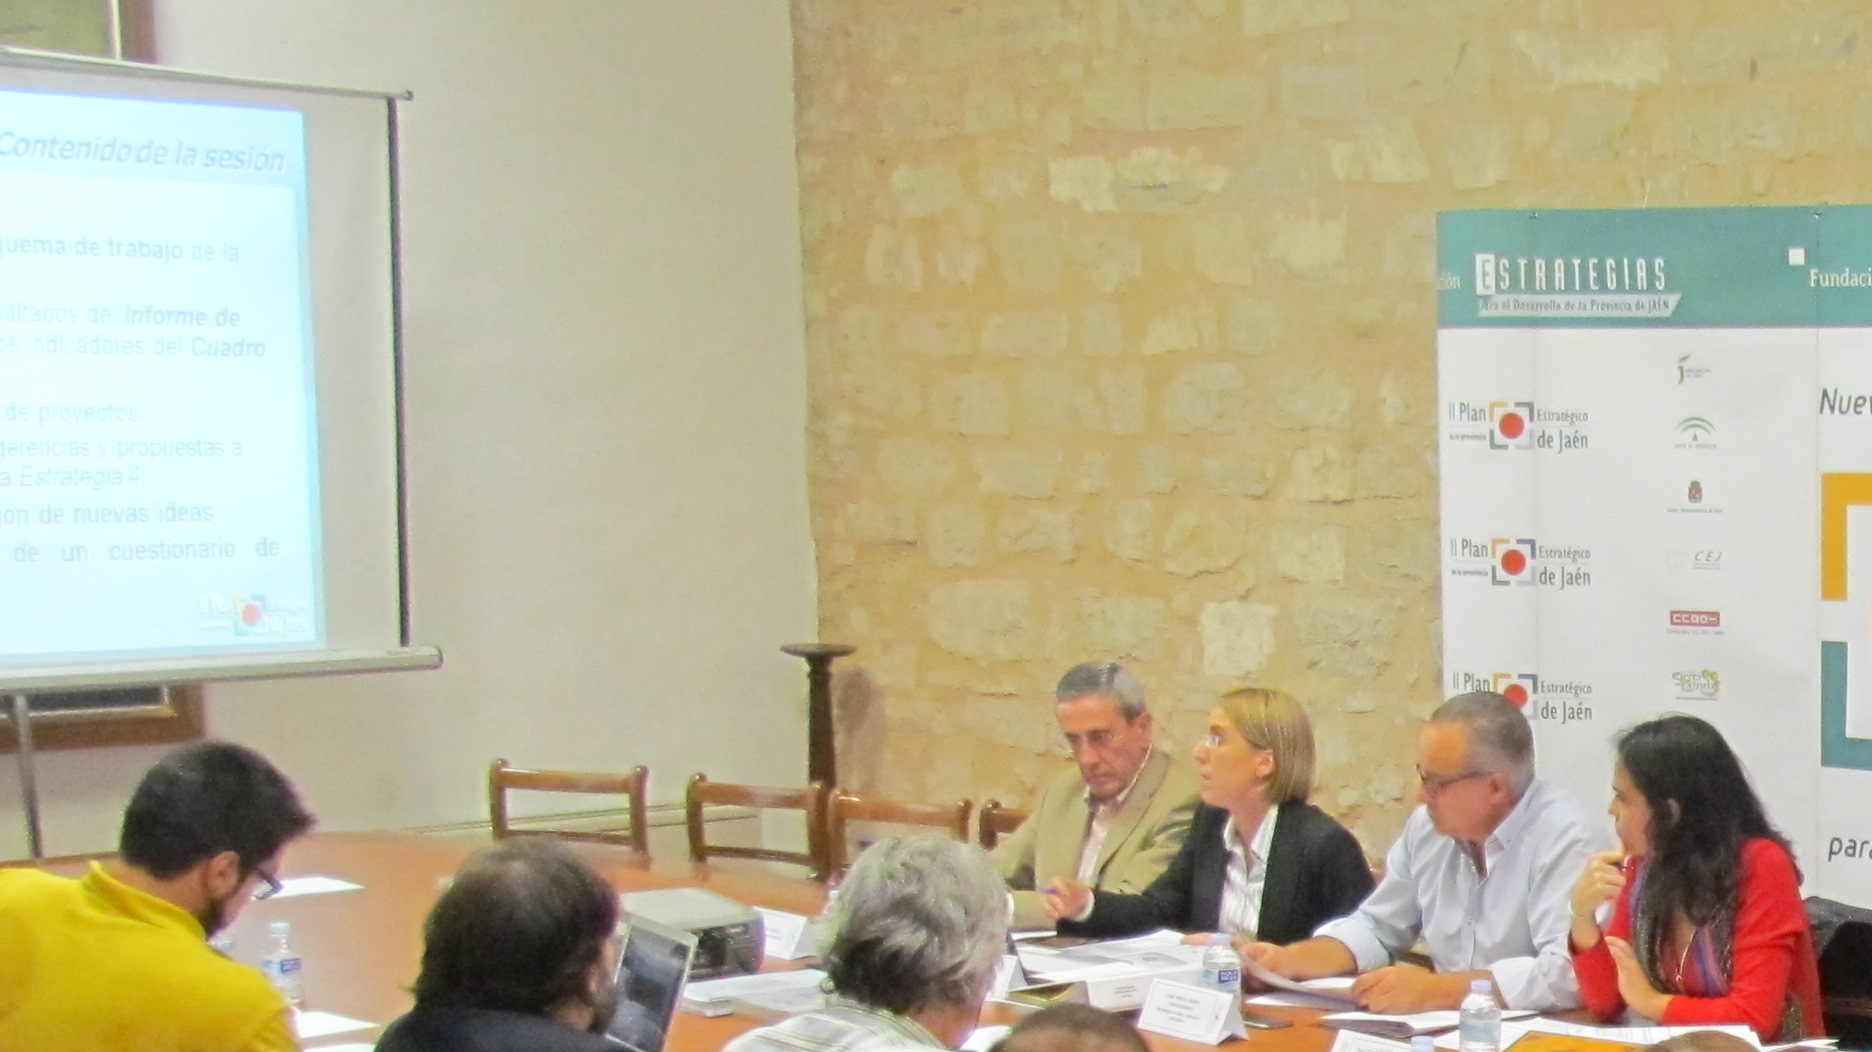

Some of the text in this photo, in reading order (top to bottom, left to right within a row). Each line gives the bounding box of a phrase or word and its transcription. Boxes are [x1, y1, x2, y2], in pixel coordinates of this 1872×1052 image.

[0, 131, 286, 172] Contenido de la sesión
[75, 236, 101, 256] de
[108, 238, 184, 264] trabajo
[192, 241, 215, 261] de
[223, 242, 240, 261] la
[1477, 256, 1665, 292] ESTRATEGIAS
[124, 303, 207, 326] Informe
[215, 306, 241, 326] de
[1590, 300, 1633, 312] Provincia
[28, 333, 145, 355] indicadores
[153, 336, 183, 356] del
[191, 336, 267, 357] Cuadro
[38, 403, 139, 428] proyectos
[1460, 402, 1487, 422] Plan
[1537, 408, 1589, 425] Estratégico
[117, 439, 226, 461] propuestas
[1537, 428, 1554, 449] de
[1558, 428, 1589, 454] Jaén
[20, 465, 124, 491] Estrategia
[39, 503, 65, 525] de
[74, 505, 150, 525] nuevas
[159, 501, 214, 523] ideas
[13, 536, 281, 563] de un cuestionario de
[1462, 538, 1489, 558] Plan
[1539, 545, 1591, 563] Estratégico
[1539, 566, 1556, 585] de
[1560, 566, 1591, 591] Jaén
[1464, 672, 1490, 693] Plan
[1541, 680, 1593, 698] Estratégico
[1541, 700, 1593, 724] de Jaén
